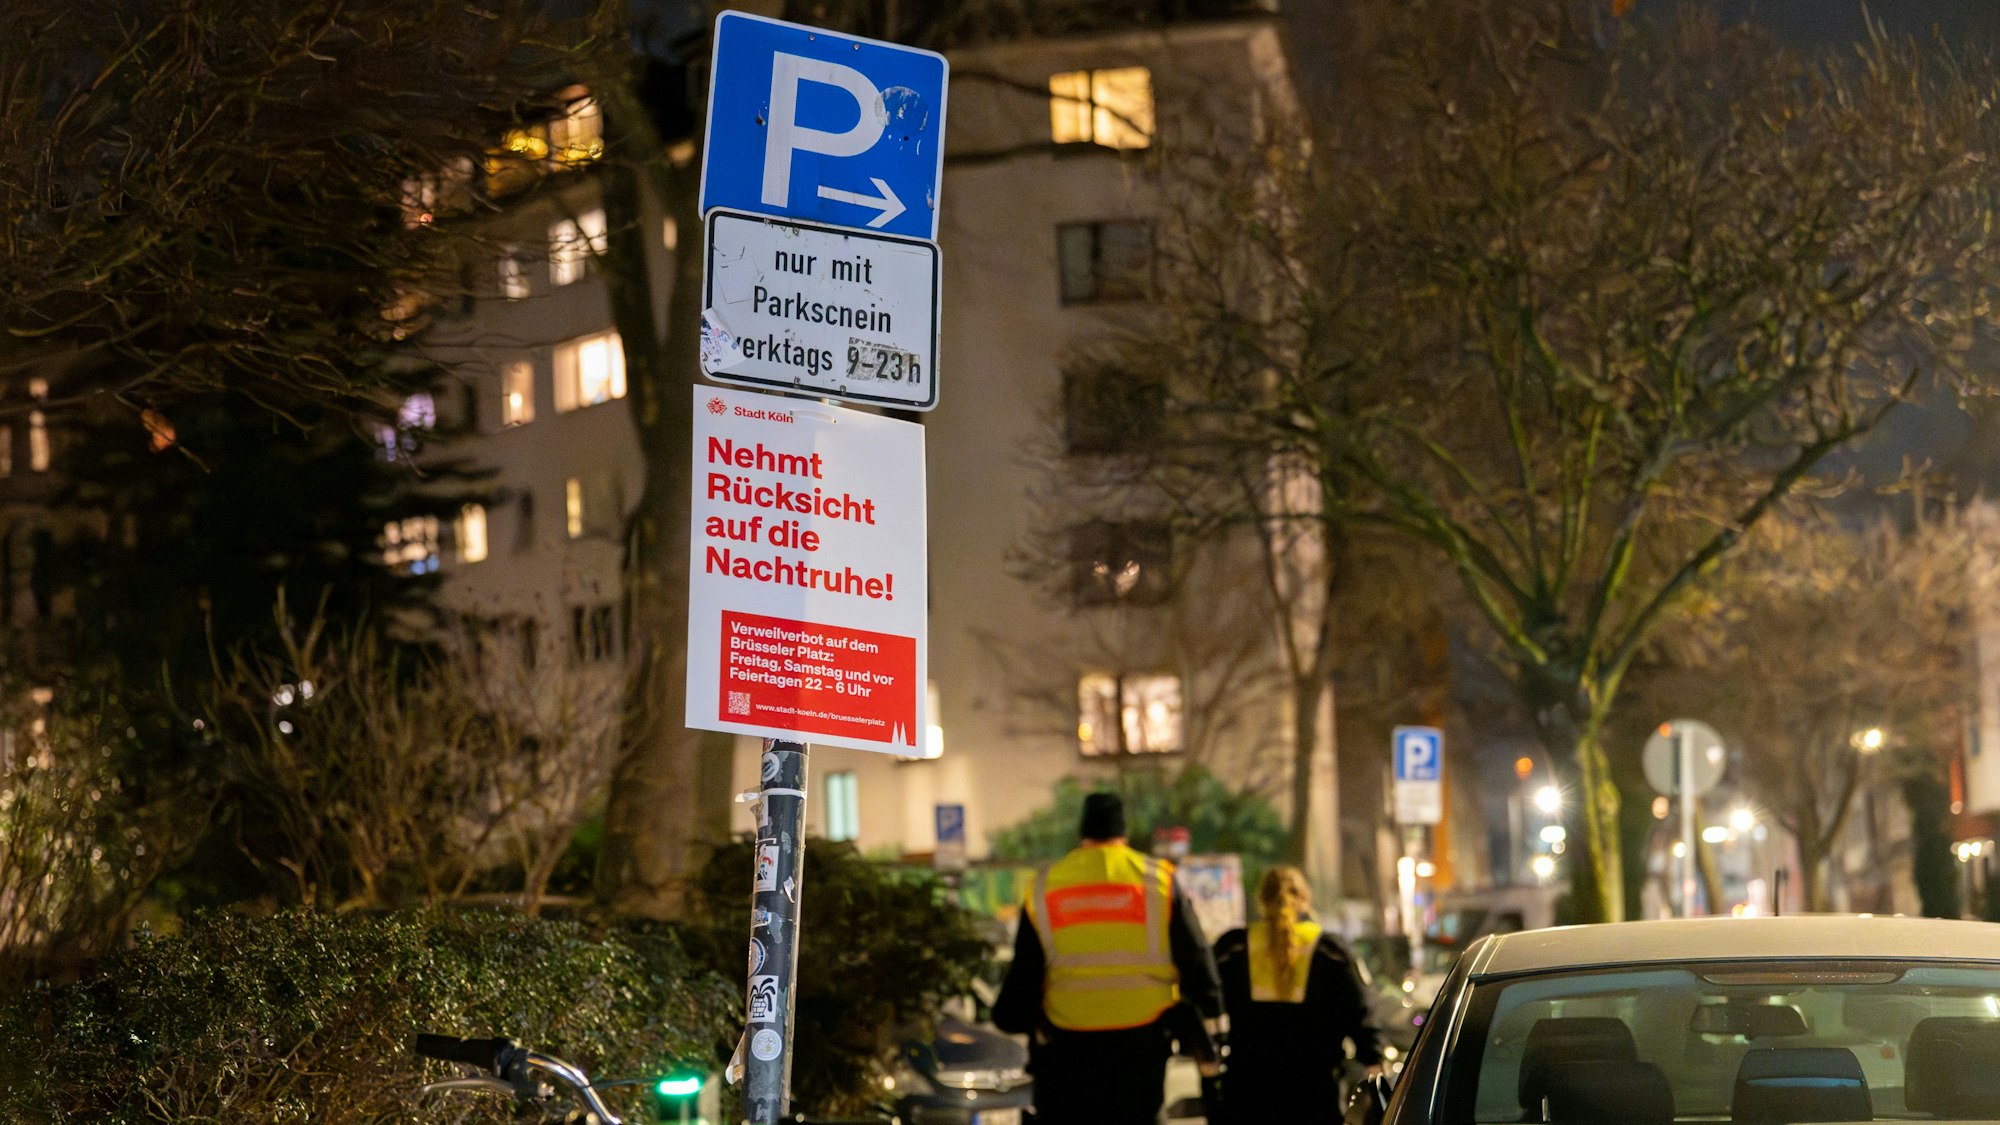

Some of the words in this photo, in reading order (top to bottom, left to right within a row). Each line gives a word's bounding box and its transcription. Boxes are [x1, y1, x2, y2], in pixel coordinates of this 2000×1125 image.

[761, 51, 887, 208] P
[775, 250, 817, 276] nur
[831, 255, 872, 285] mit
[736, 334, 833, 376] erktags
[734, 406, 766, 420] Stadt
[768, 411, 794, 423] Köln
[708, 437, 823, 479] Nehmt
[707, 472, 875, 525] Rücksicht
[705, 516, 763, 543] auf
[768, 520, 820, 552] die
[706, 546, 893, 601] Nachtruhe!
[730, 620, 824, 646] Verweilverbot
[825, 637, 848, 650] auf
[849, 638, 879, 654] dem
[730, 636, 795, 657] Brüsseler
[797, 645, 835, 663] Platz:
[729, 666, 802, 689] Feiertagen
[804, 677, 823, 691] 22
[835, 681, 845, 694] 6
[847, 682, 872, 698] Uhr
[730, 651, 782, 672] Freitag,
[783, 658, 843, 681] Samstag
[845, 670, 871, 683] und
[872, 673, 895, 686] vor
[755, 703, 886, 727] www.stadt-koeln.de/bruesselerplatz
[1404, 736, 1433, 780] P
